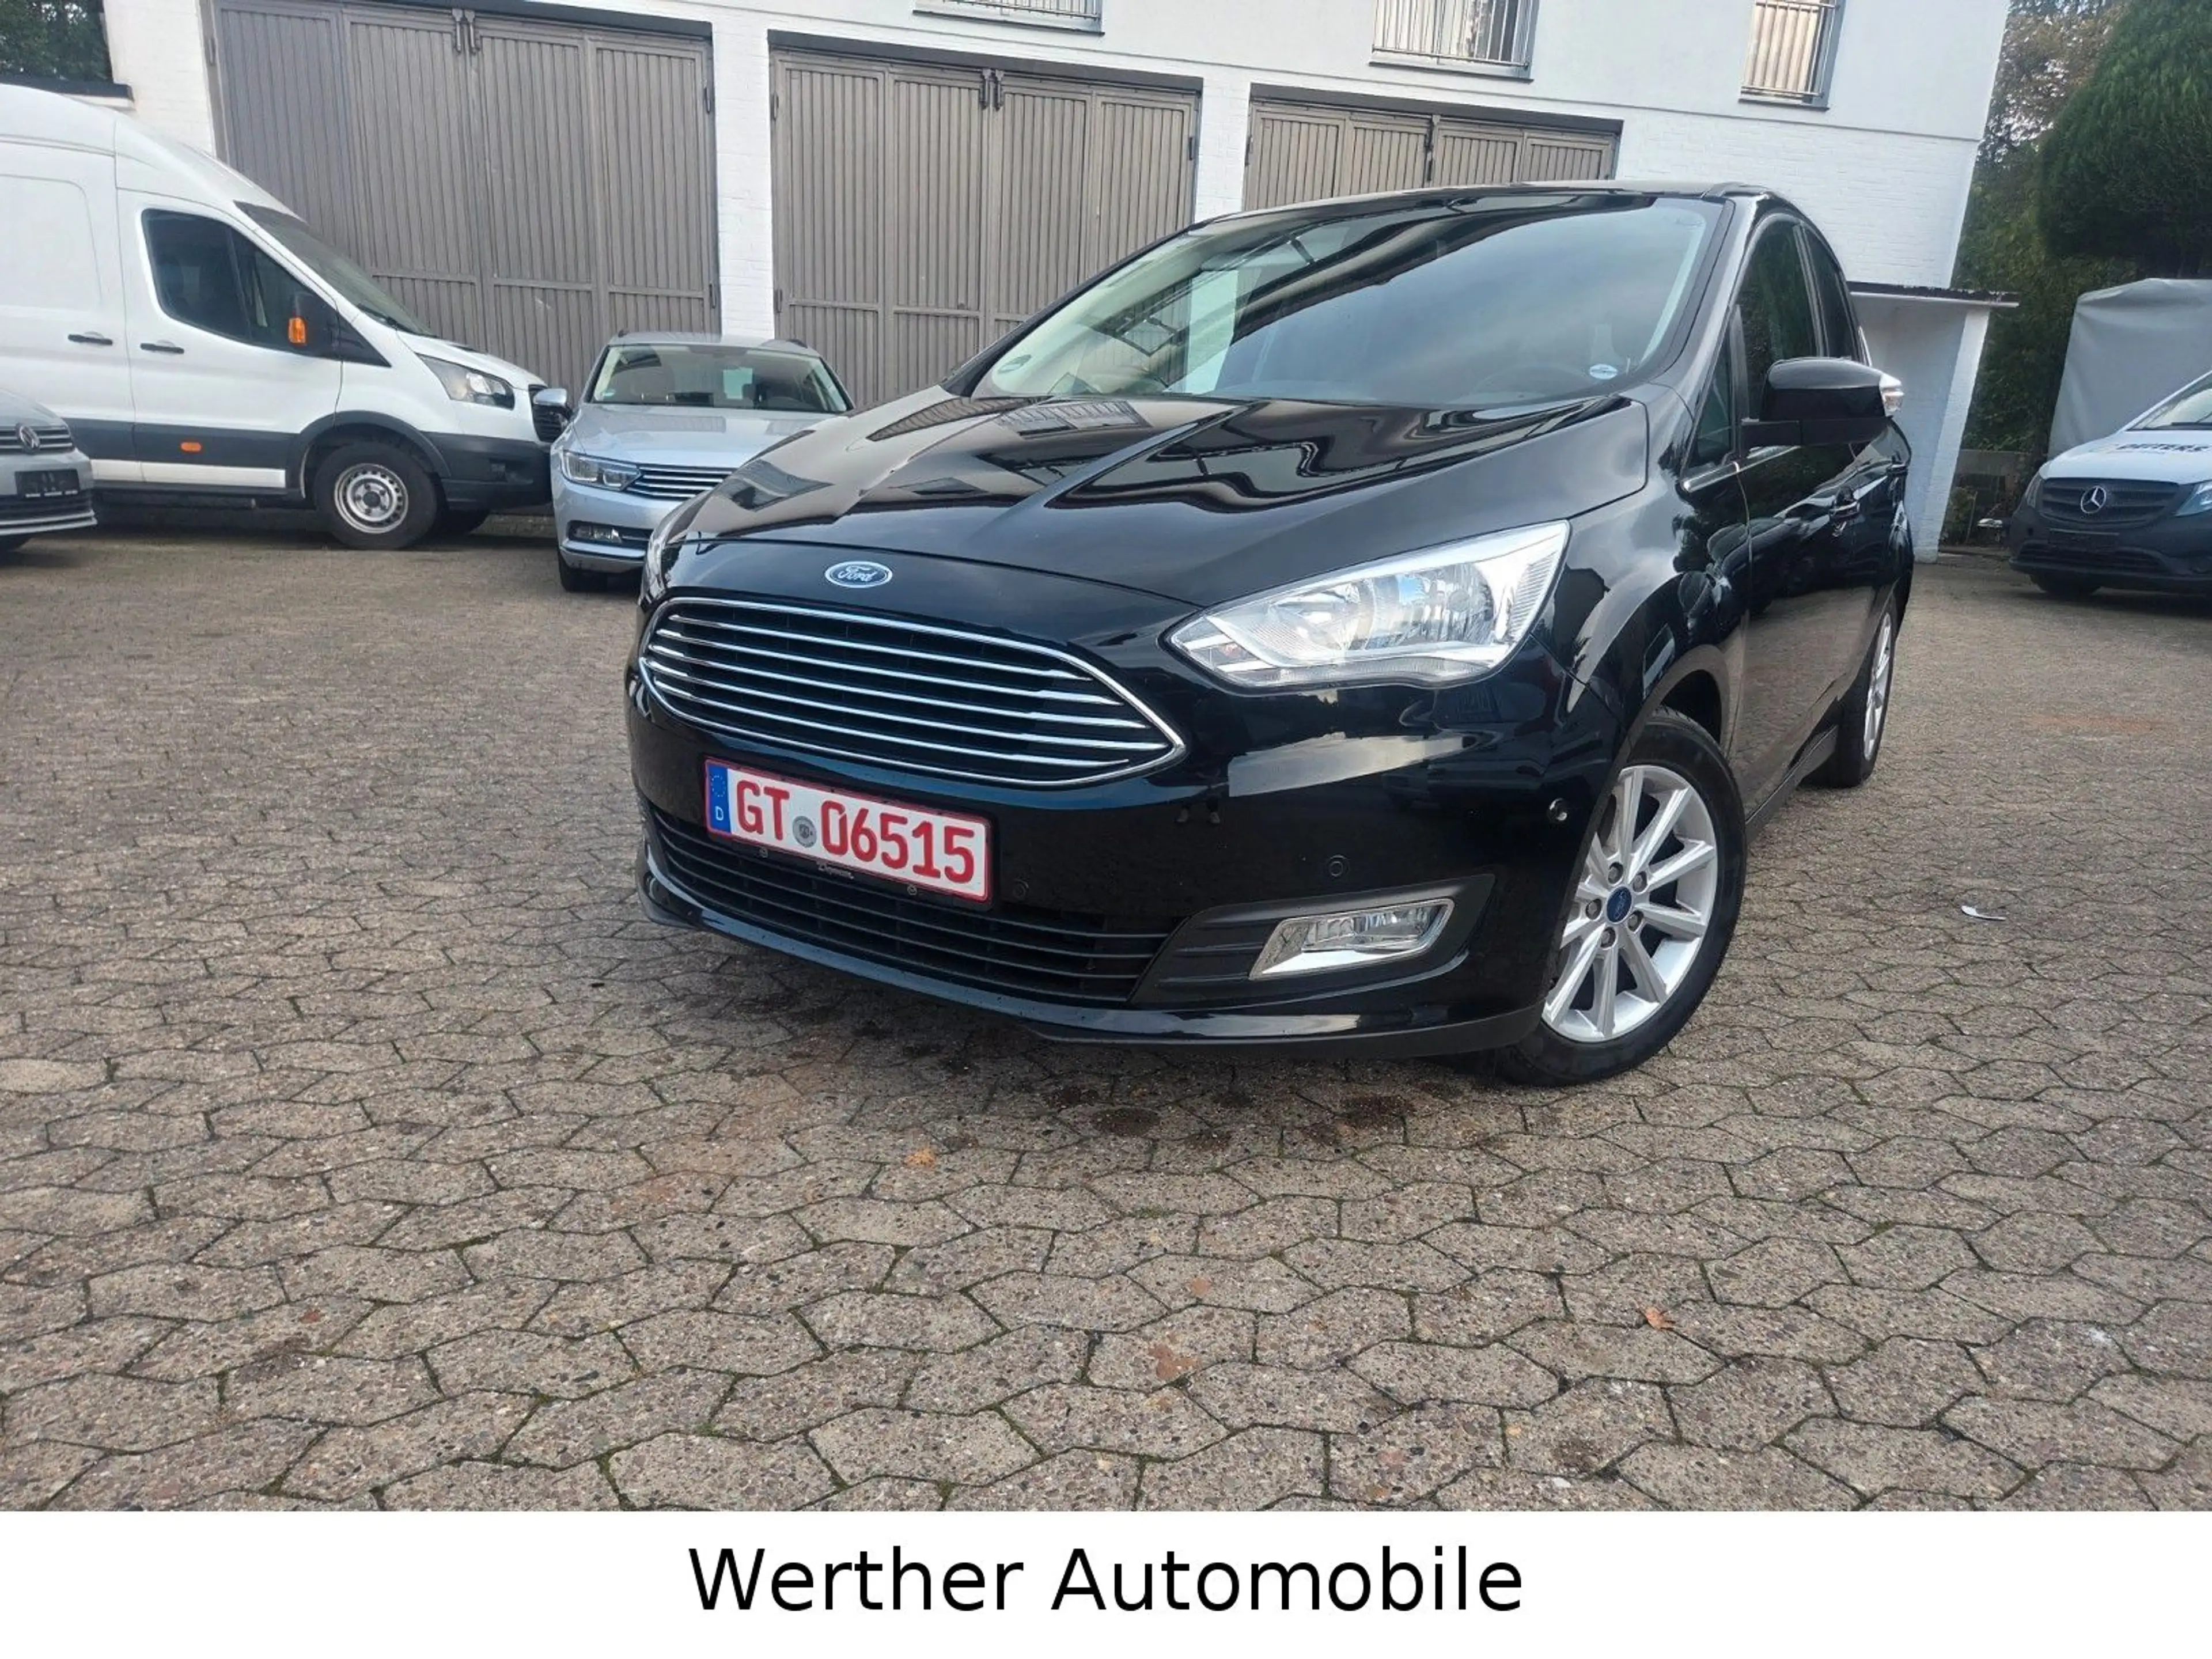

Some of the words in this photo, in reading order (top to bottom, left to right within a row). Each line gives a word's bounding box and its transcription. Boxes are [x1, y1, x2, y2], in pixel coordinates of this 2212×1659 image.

[838, 565, 877, 582] Ford
[715, 805, 724, 821] D
[736, 779, 790, 841] GT
[820, 800, 975, 884] 06515
